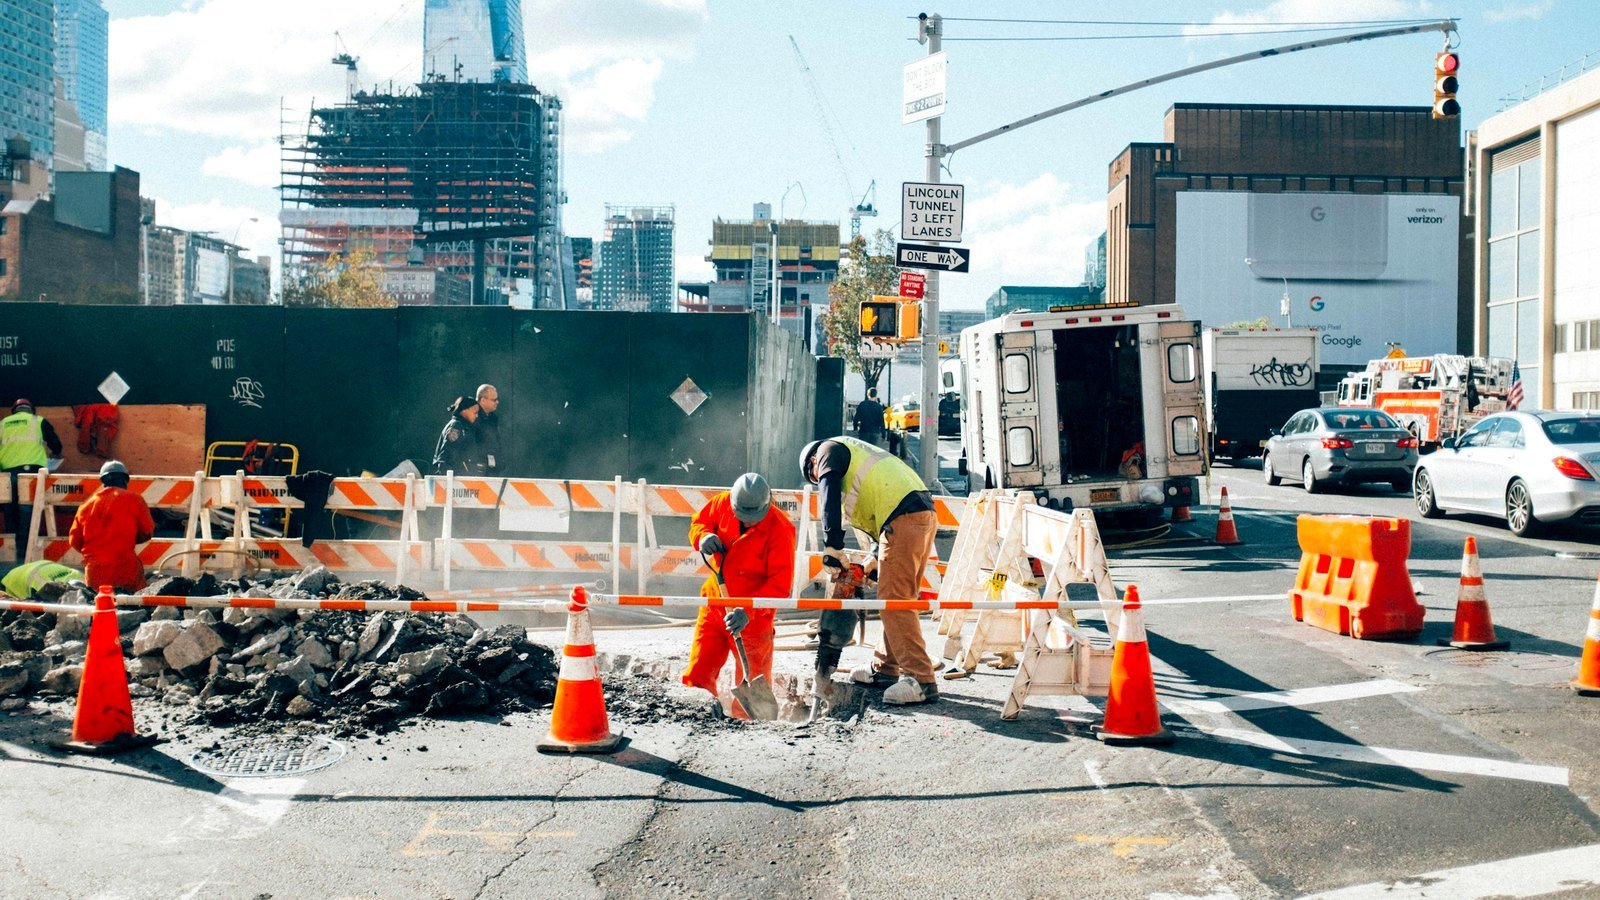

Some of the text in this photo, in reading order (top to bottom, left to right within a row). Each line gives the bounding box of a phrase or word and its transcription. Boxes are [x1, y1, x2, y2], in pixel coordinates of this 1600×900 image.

[907, 187, 959, 199] LINCOLN
[909, 200, 957, 212] TUNNEL
[911, 213, 954, 224] 3 LEFT
[1407, 214, 1443, 224] verizon
[912, 226, 952, 237] LANES
[907, 251, 959, 265] ONE WAY
[1321, 334, 1362, 348] Google
[1, 353, 28, 366] BILLS
[52, 484, 84, 494] TRIUMPH
[452, 488, 480, 498] RIUMPH
[247, 549, 280, 560] TRIUMPH
